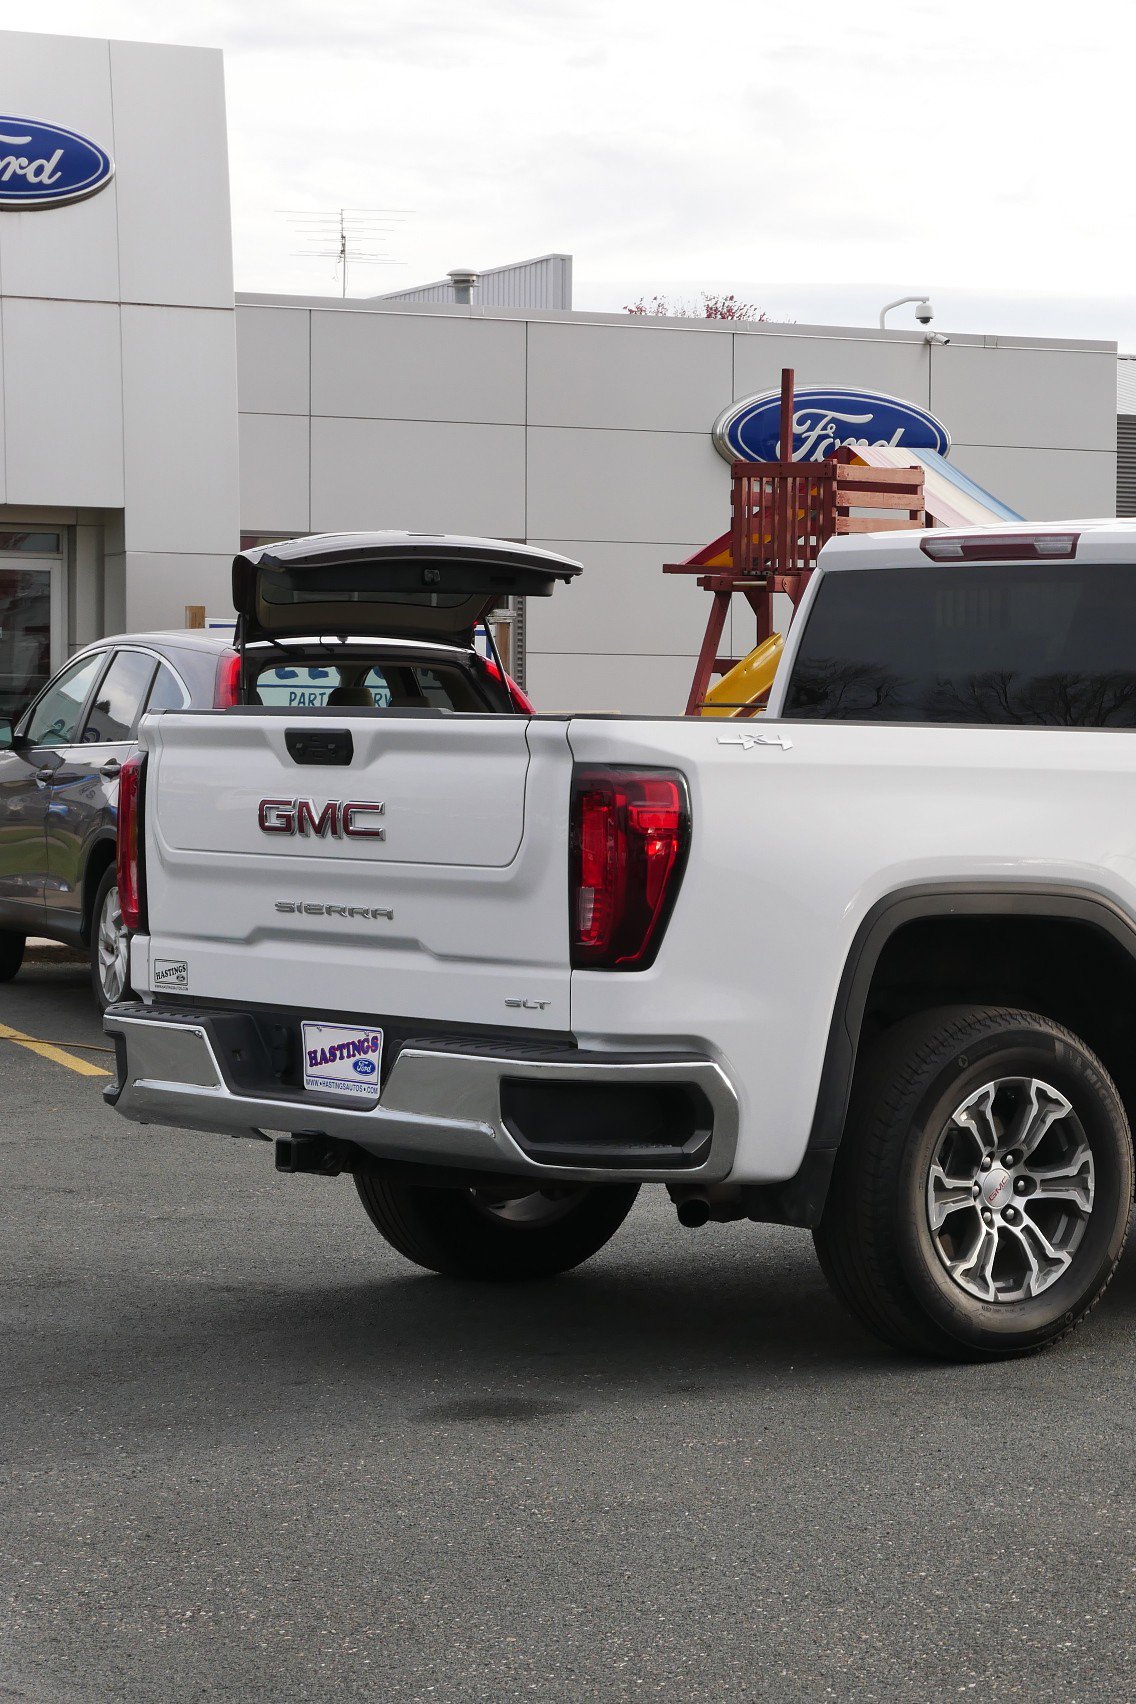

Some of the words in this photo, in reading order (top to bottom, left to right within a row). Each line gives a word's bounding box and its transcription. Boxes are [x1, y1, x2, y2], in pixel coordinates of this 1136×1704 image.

[258, 797, 386, 841] GMC
[274, 900, 394, 921] SIERRA
[155, 964, 187, 981] HASTINGS
[504, 997, 552, 1011] SLT
[307, 1035, 379, 1067] HASTINGS
[356, 1060, 373, 1073] Ford
[988, 1175, 1009, 1202] GMC
